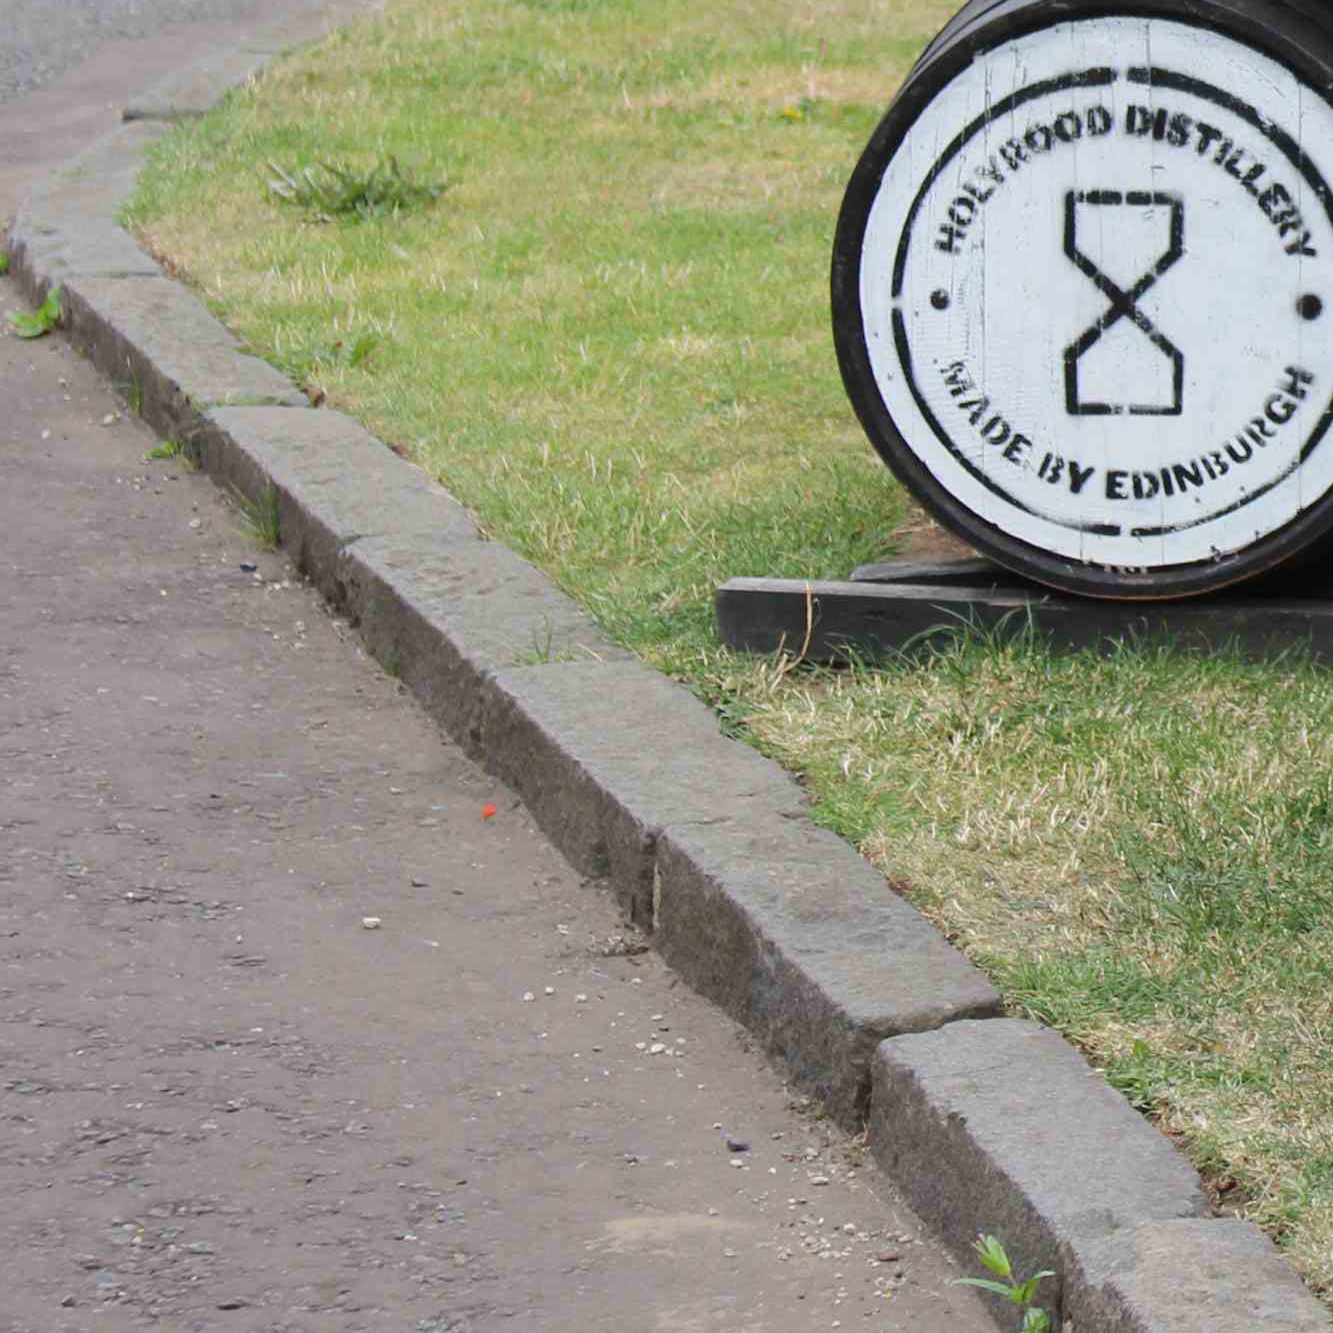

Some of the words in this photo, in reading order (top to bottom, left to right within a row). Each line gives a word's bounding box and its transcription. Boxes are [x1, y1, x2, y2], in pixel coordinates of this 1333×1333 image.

[934, 105, 1113, 256] HOLYROOD
[1124, 104, 1318, 258] DISTILLERY
[938, 361, 1033, 465] MADE
[1037, 452, 1092, 494] BY
[1105, 365, 1314, 500] EDINBURGH
